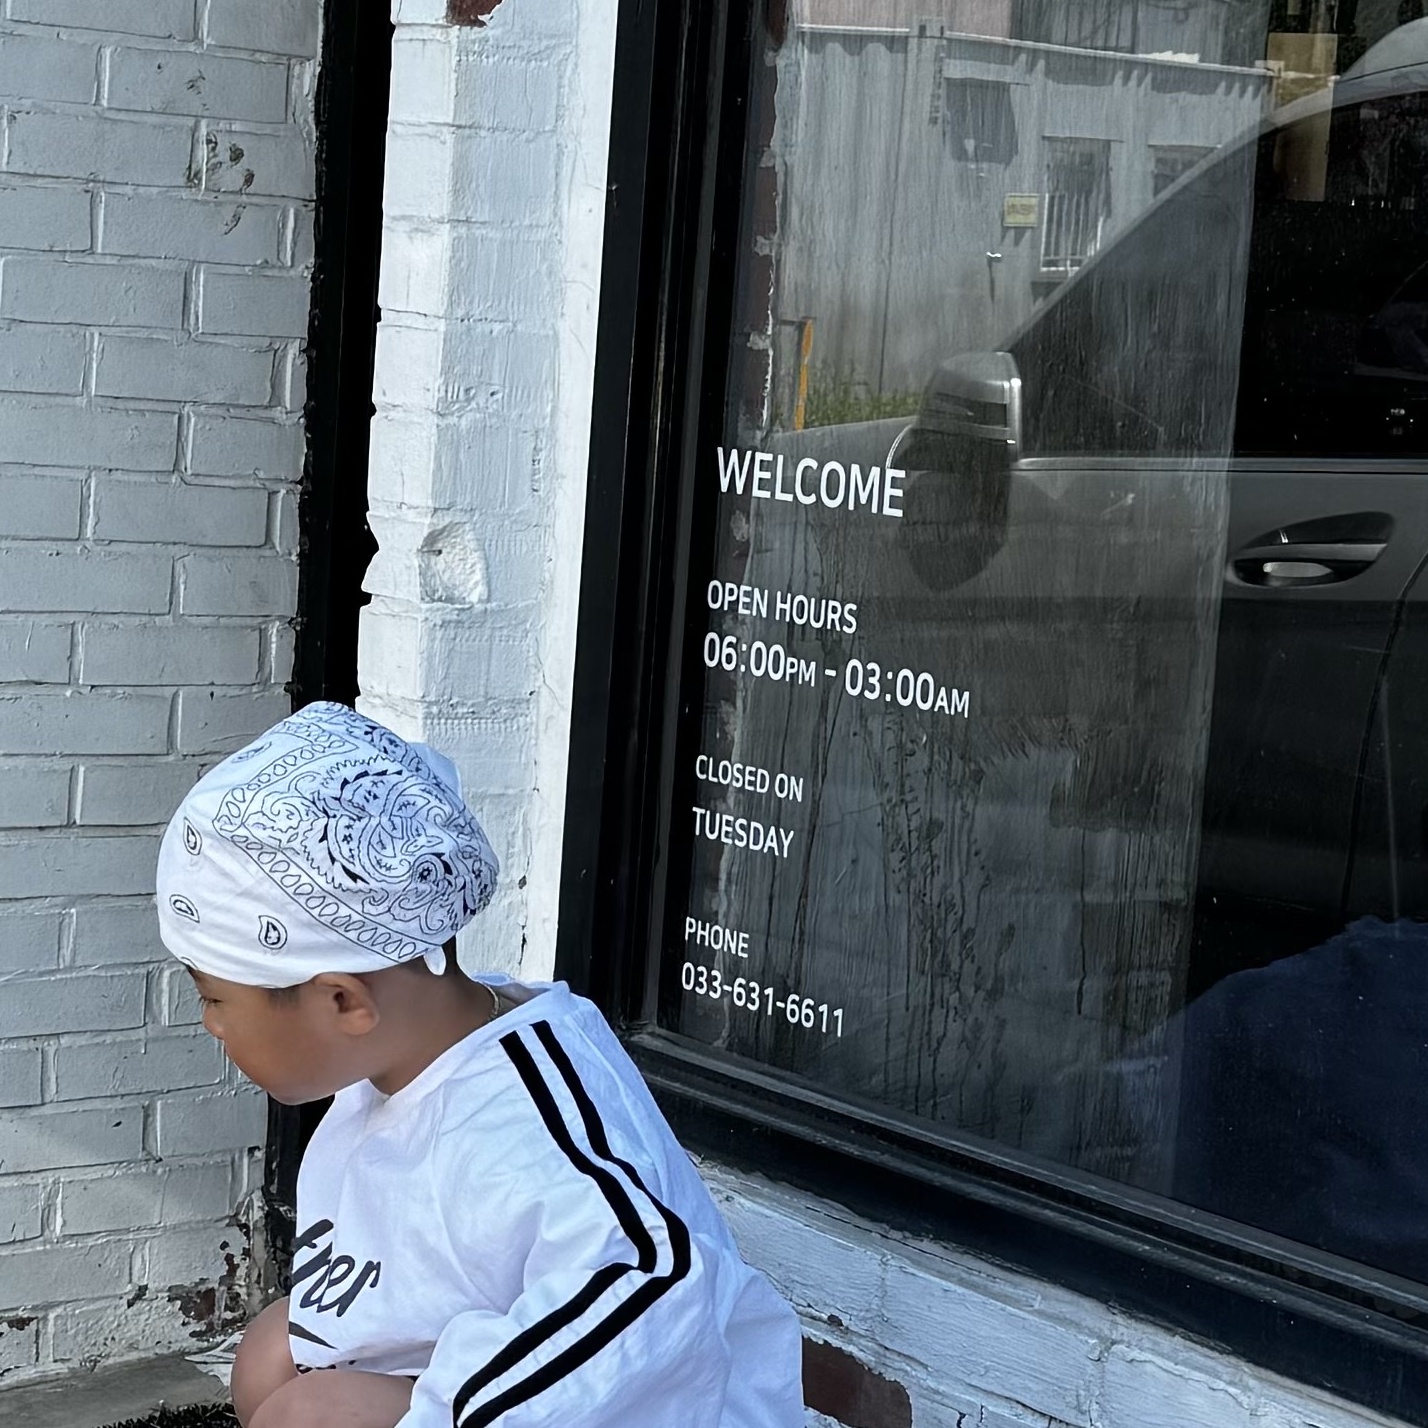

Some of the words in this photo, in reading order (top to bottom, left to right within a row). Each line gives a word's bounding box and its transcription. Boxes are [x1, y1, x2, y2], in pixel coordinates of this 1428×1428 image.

[717, 446, 906, 518] WELCOME
[707, 579, 769, 619] OPEN
[775, 590, 858, 634] HOURS
[703, 631, 816, 688] 06:00PM
[844, 658, 971, 719] 03:00AM
[695, 754, 770, 794] CLOSED
[774, 773, 804, 802] ON
[692, 806, 795, 858] TUESDAY
[684, 916, 750, 958] PHONE
[681, 961, 844, 1038] 033-631-6611
